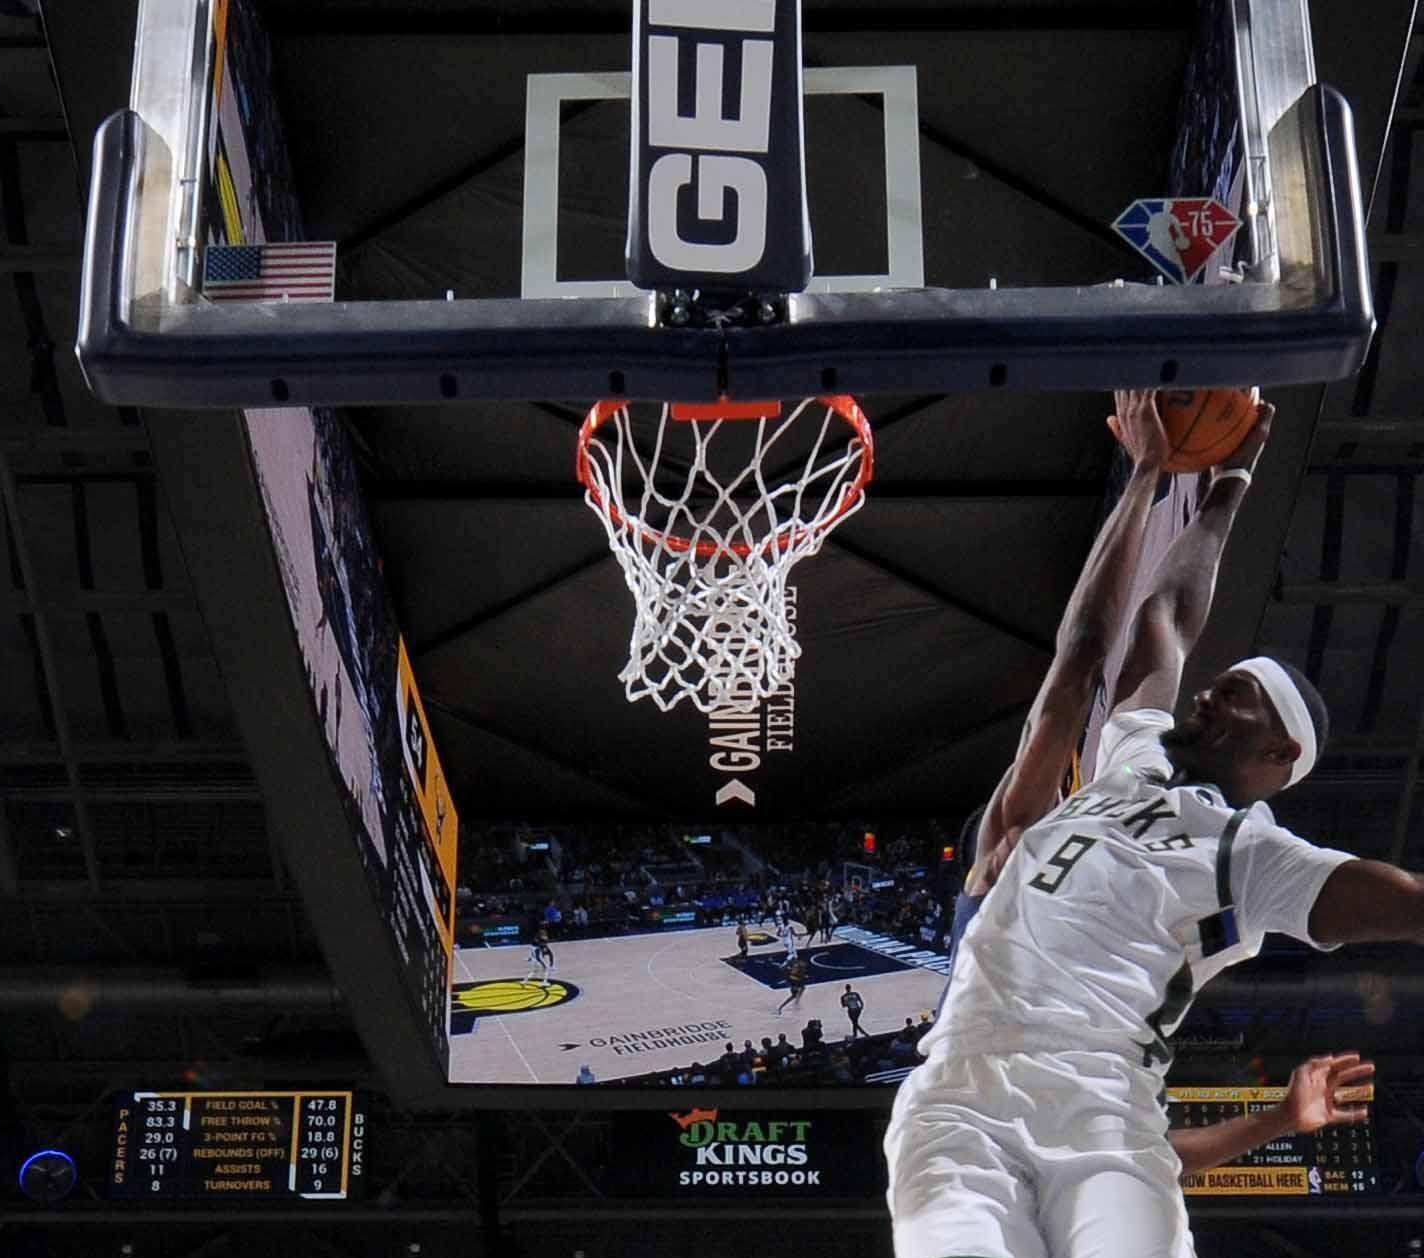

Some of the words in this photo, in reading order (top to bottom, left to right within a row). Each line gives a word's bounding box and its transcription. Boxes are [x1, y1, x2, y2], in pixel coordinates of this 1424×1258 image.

[1188, 211, 1214, 238] 75
[1028, 833, 1098, 894] 9
[589, 1018, 733, 1051] GAINBRIDGE
[612, 1030, 730, 1057] FIELDHOUSE
[148, 1100, 176, 1112] 35.3
[205, 1101, 236, 1111] FIELD
[238, 1101, 267, 1111] GOAL
[308, 1099, 336, 1111] 47.8
[201, 1117, 228, 1127] FREE
[230, 1116, 270, 1126] THROW
[307, 1115, 335, 1127] 70.0
[145, 1132, 174, 1144] 29.0
[307, 1131, 335, 1142] 18.8
[679, 1120, 812, 1147] DRAFT
[114, 1109, 129, 1184] PACERS
[352, 1113, 364, 1176] BUCKS
[1265, 1142, 1293, 1151] ALLEN
[139, 1148, 157, 1160] 26
[159, 1148, 177, 1161] (7)
[193, 1148, 254, 1159] REBOUNDS
[301, 1148, 319, 1159] 29
[321, 1148, 339, 1160] (6)
[696, 1142, 808, 1165] KINGS
[1266, 1155, 1303, 1163] HOLIDAY
[150, 1164, 164, 1175] 11
[214, 1164, 261, 1174] ASSISTS
[311, 1164, 327, 1174] 16
[679, 1170, 820, 1185] SPORTSBOOK
[1207, 1173, 1274, 1189] BASKETBALL
[1276, 1173, 1303, 1188] HERE
[151, 1180, 161, 1191] 8
[205, 1180, 271, 1190] TURNOVERS
[314, 1180, 323, 1191] 9
